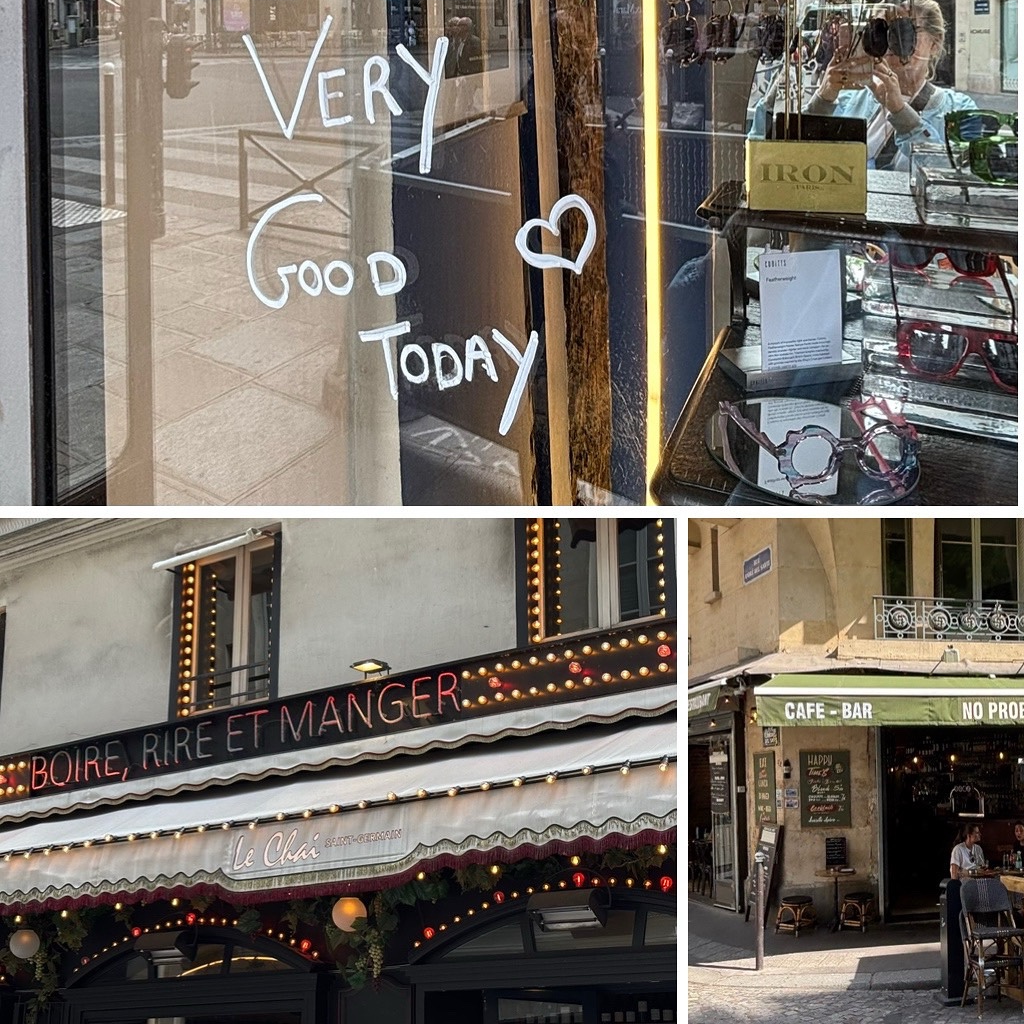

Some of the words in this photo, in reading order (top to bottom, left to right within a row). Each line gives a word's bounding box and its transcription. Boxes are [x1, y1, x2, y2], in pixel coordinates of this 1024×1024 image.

[242, 15, 449, 174] VERY
[760, 163, 855, 183] IRON
[246, 194, 407, 309] GOOD
[765, 275, 797, 283] Featherweight
[358, 320, 539, 436] TODAY
[784, 701, 825, 720] CAFE
[841, 702, 873, 720] BAR
[962, 701, 983, 720] NO
[31, 740, 129, 791] BOIRE,
[142, 720, 214, 770] RIRE
[226, 709, 269, 753] ET
[280, 671, 461, 744] MANGER
[807, 754, 833, 767] HAPPY
[232, 834, 255, 871] Le
[263, 828, 320, 868] Chai
[324, 829, 402, 848] SAINT-GERMAIN
